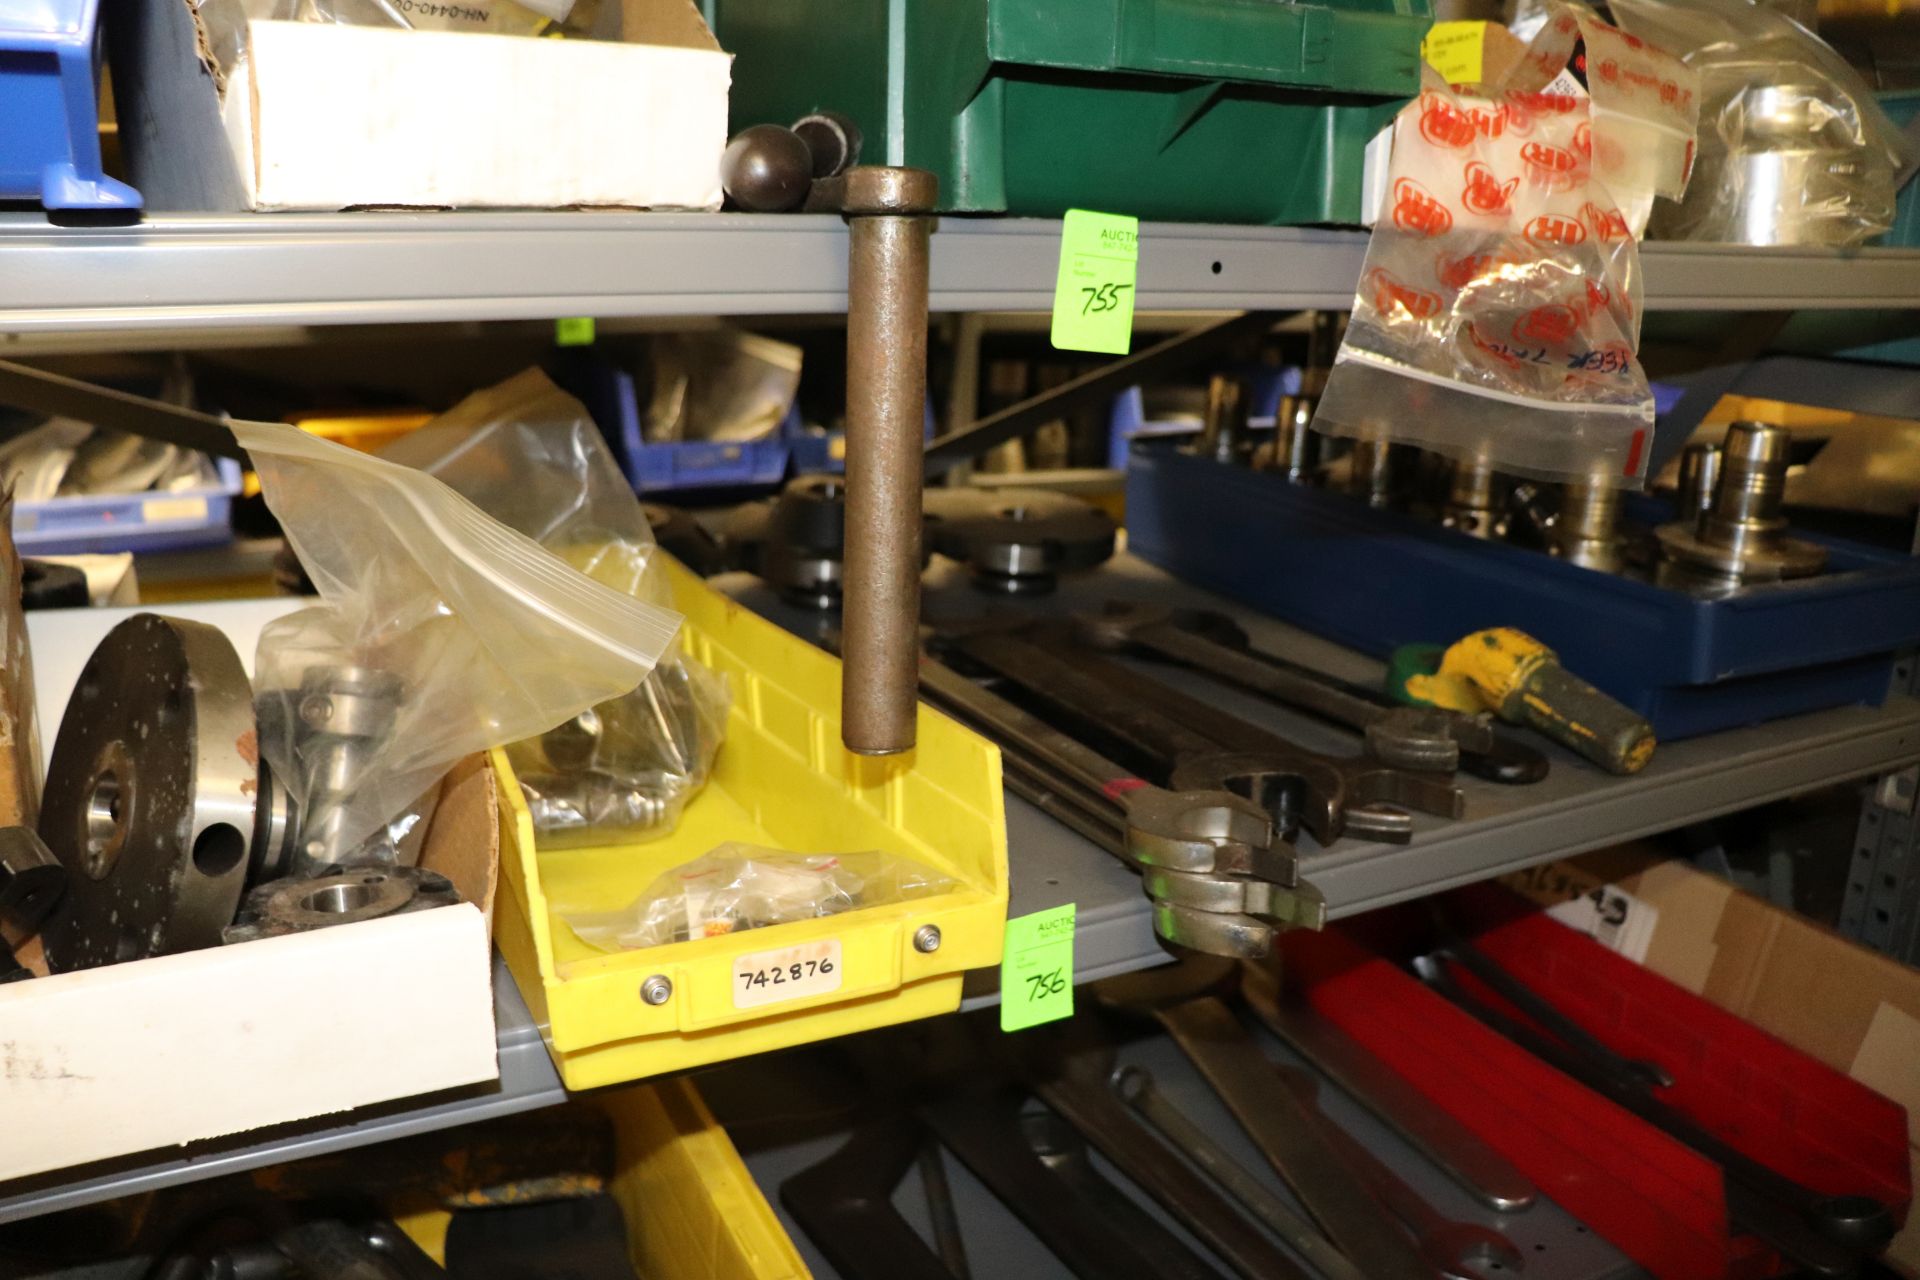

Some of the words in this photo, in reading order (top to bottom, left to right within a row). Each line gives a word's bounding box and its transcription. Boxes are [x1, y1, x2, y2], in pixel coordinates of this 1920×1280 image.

[1536, 215, 1579, 245] IR
[1081, 282, 1133, 317] 755
[739, 957, 834, 990] 742876
[1025, 966, 1066, 1002] 756
